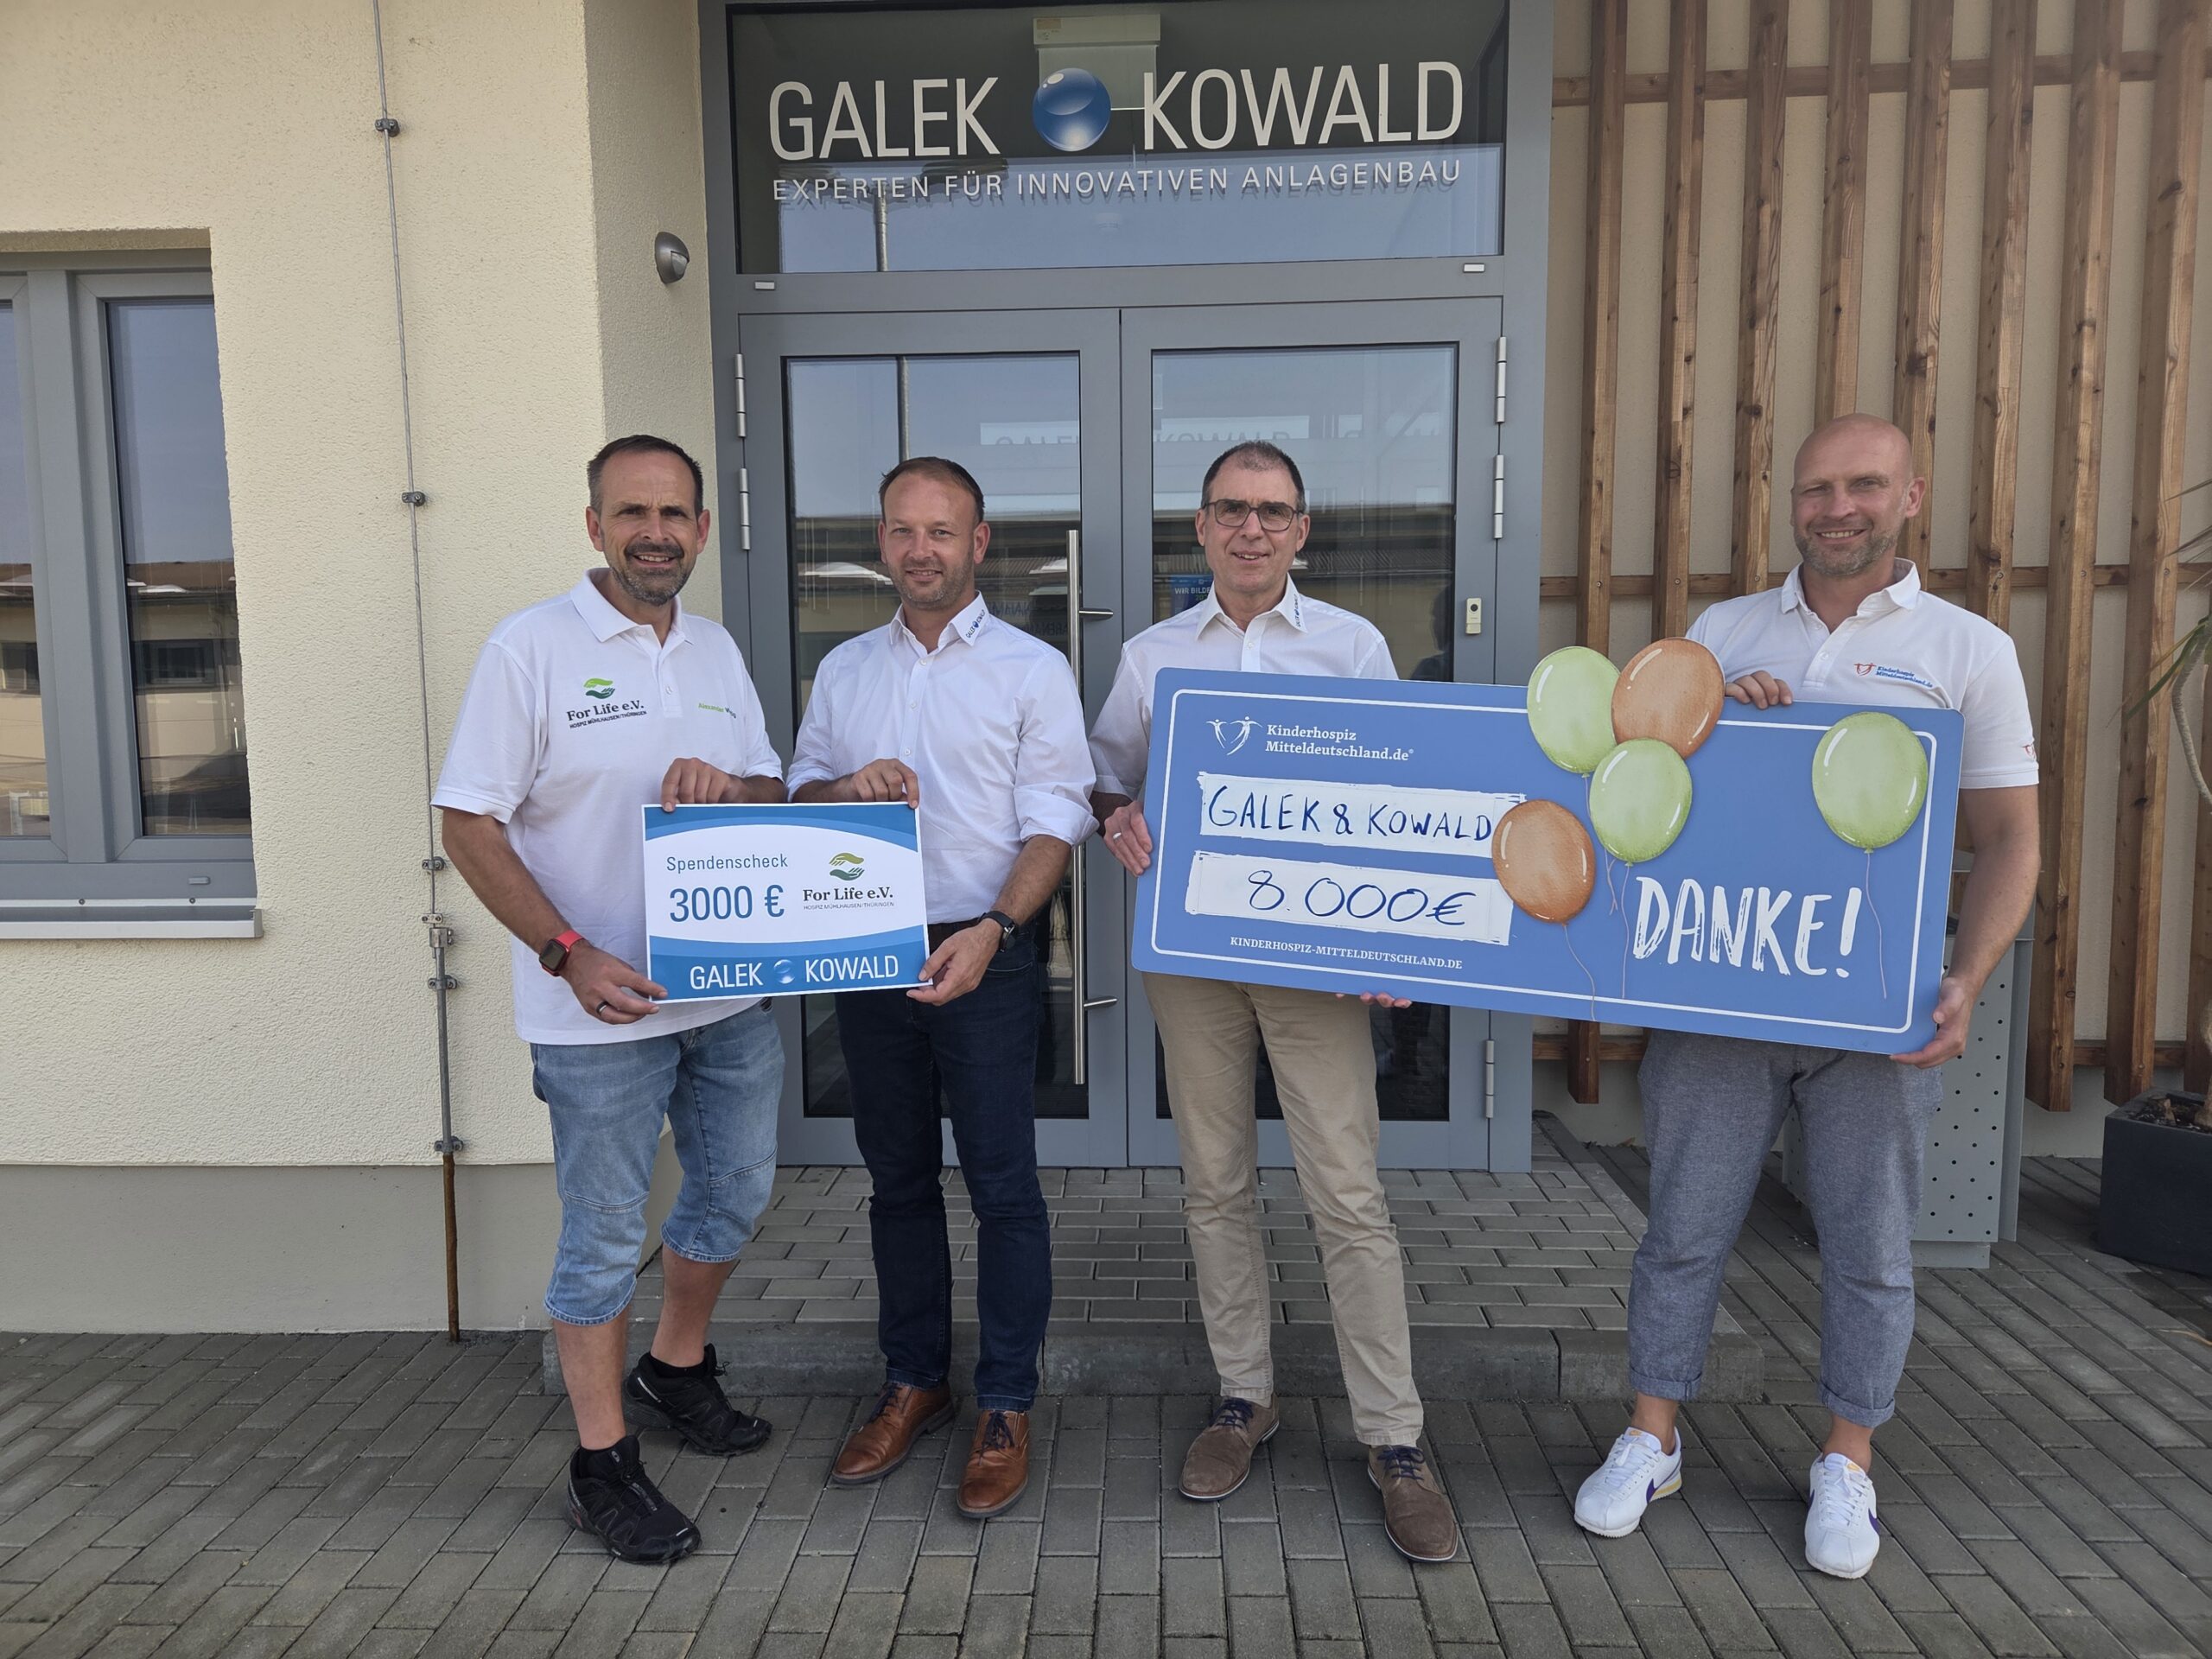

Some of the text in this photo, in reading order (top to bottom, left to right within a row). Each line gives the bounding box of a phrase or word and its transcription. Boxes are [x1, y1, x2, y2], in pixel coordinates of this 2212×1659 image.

[768, 60, 1464, 162] GALEK KOWALD
[773, 159, 1462, 201] EXPERTEN FÜR INNOVATIVEN ANLAGENBAU
[566, 700, 645, 721] For Life e.V.
[1267, 725, 1357, 743] Kinderhospiz
[1209, 785, 1492, 842] GALEK & KOWALD
[666, 854, 788, 874] Spendenscheck
[670, 885, 785, 922] 3000 €
[803, 887, 893, 901] For Life e.V.
[1632, 876, 1862, 978] DANKE!
[1230, 937, 1463, 969] KINDERHOSPIZ-MITTELDEUTSCHLAND.DE
[690, 955, 899, 990] GALEK KOWALD
